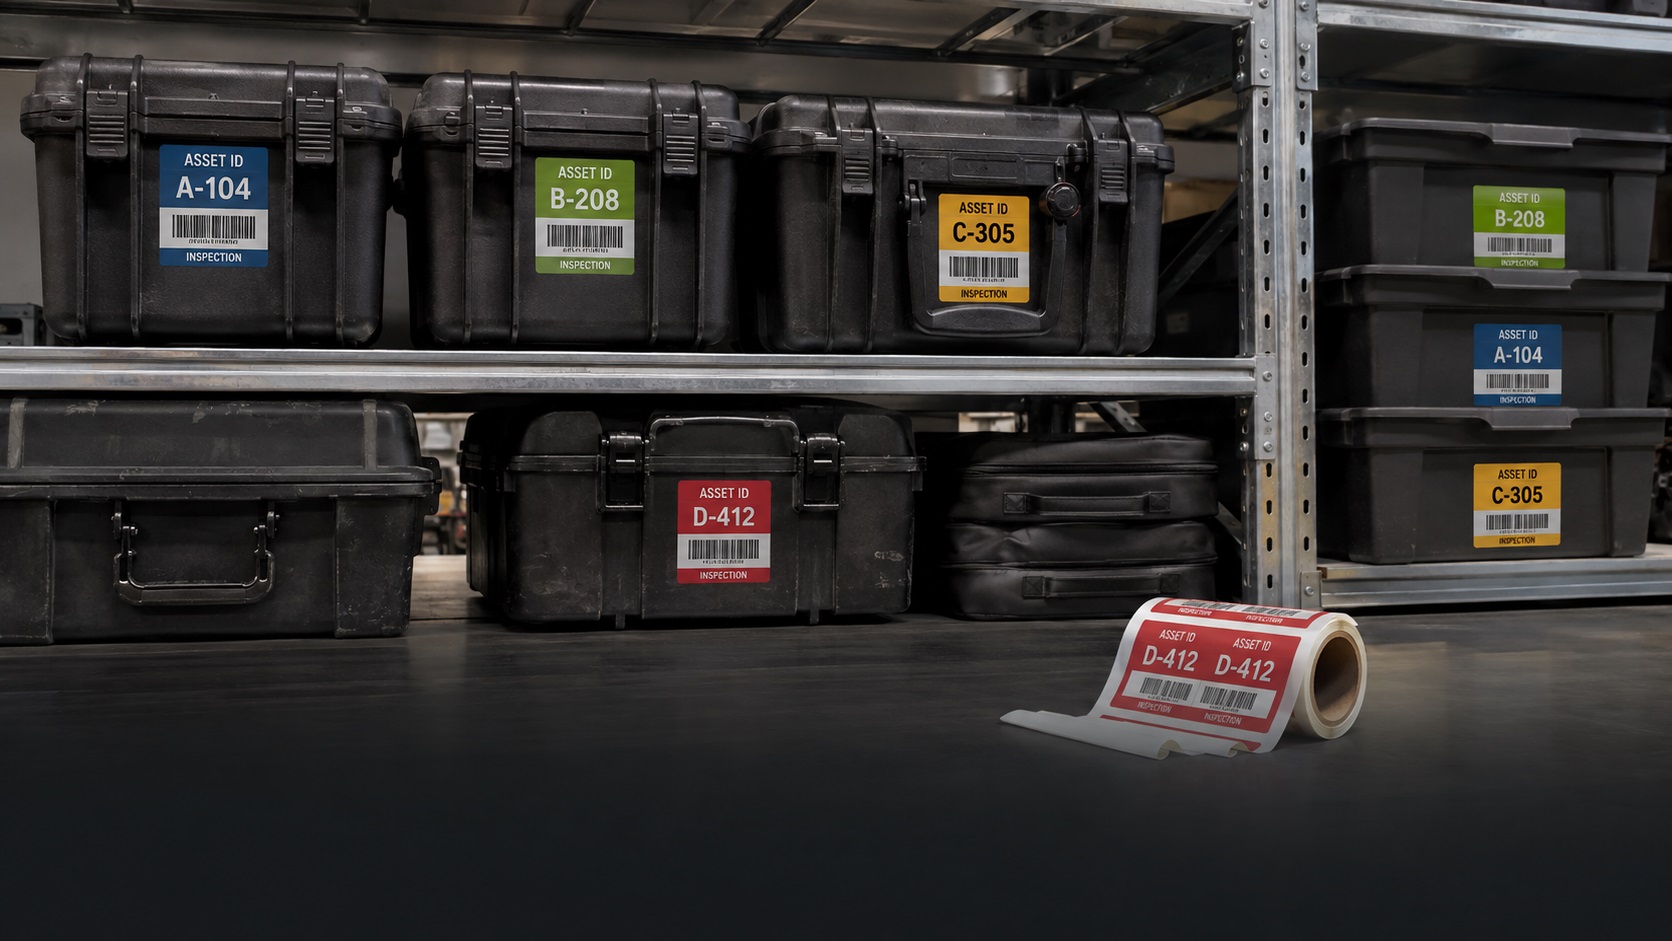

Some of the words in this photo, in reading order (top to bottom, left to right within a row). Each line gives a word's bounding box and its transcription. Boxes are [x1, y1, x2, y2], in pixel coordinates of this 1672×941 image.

[184, 153, 226, 167] ASSET
[231, 154, 244, 167] ID
[558, 166, 596, 179] ASSET
[600, 167, 613, 180] ID
[176, 176, 251, 200] A-104
[550, 187, 619, 211] B-208
[1500, 192, 1528, 203] ASSET
[1531, 193, 1540, 204] ID
[959, 201, 993, 214] ASSET
[997, 203, 1008, 214] ID
[1495, 209, 1545, 228] B-208
[953, 221, 1015, 243] C-305
[186, 252, 242, 262] INSPECTION
[560, 260, 611, 270] INSPECTION
[961, 289, 1007, 298] INSPECTION
[1498, 329, 1526, 340] ASSET
[1529, 329, 1538, 340] ID
[1493, 346, 1543, 364] A-104
[1498, 469, 1525, 480] ASSET
[1528, 468, 1537, 479] ID
[699, 487, 734, 499] ASSET
[738, 487, 749, 499] ID
[1492, 486, 1543, 504] C-305
[693, 506, 755, 526] D-412
[700, 571, 747, 579] INSPECTION
[1159, 629, 1185, 641] ASSET
[1186, 632, 1196, 642] ID
[1233, 637, 1262, 650] ASSET
[1262, 640, 1271, 651] ID
[1142, 645, 1198, 672] D-412
[1214, 654, 1275, 682] D-412
